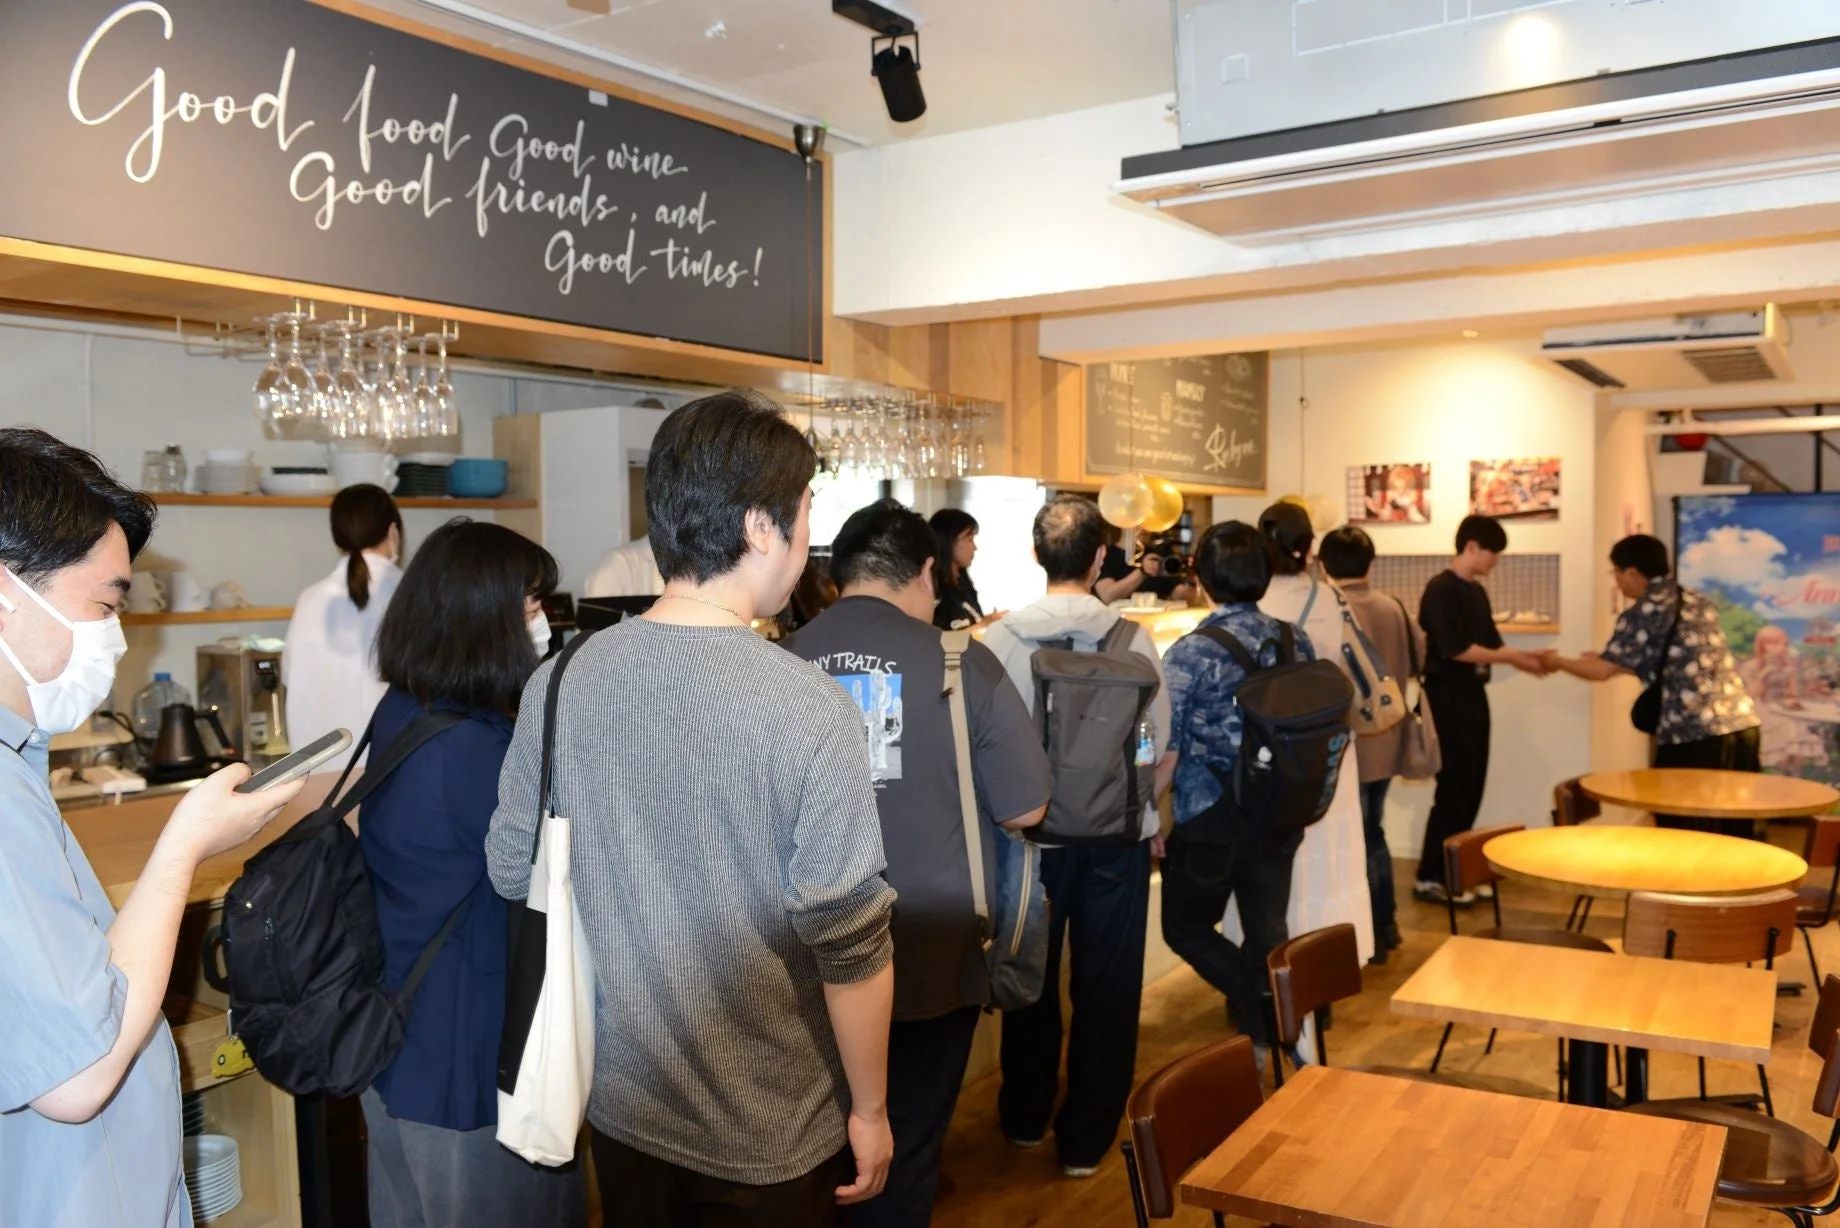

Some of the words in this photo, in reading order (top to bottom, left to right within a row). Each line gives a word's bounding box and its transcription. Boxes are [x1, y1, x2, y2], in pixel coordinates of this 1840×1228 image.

[68, 1, 315, 183] Good
[342, 64, 471, 174] food
[489, 114, 596, 180] Good
[606, 143, 688, 179] wine
[290, 151, 453, 230] Good
[655, 191, 716, 234] and
[545, 229, 648, 294] Good
[833, 652, 896, 677] TRAILS
